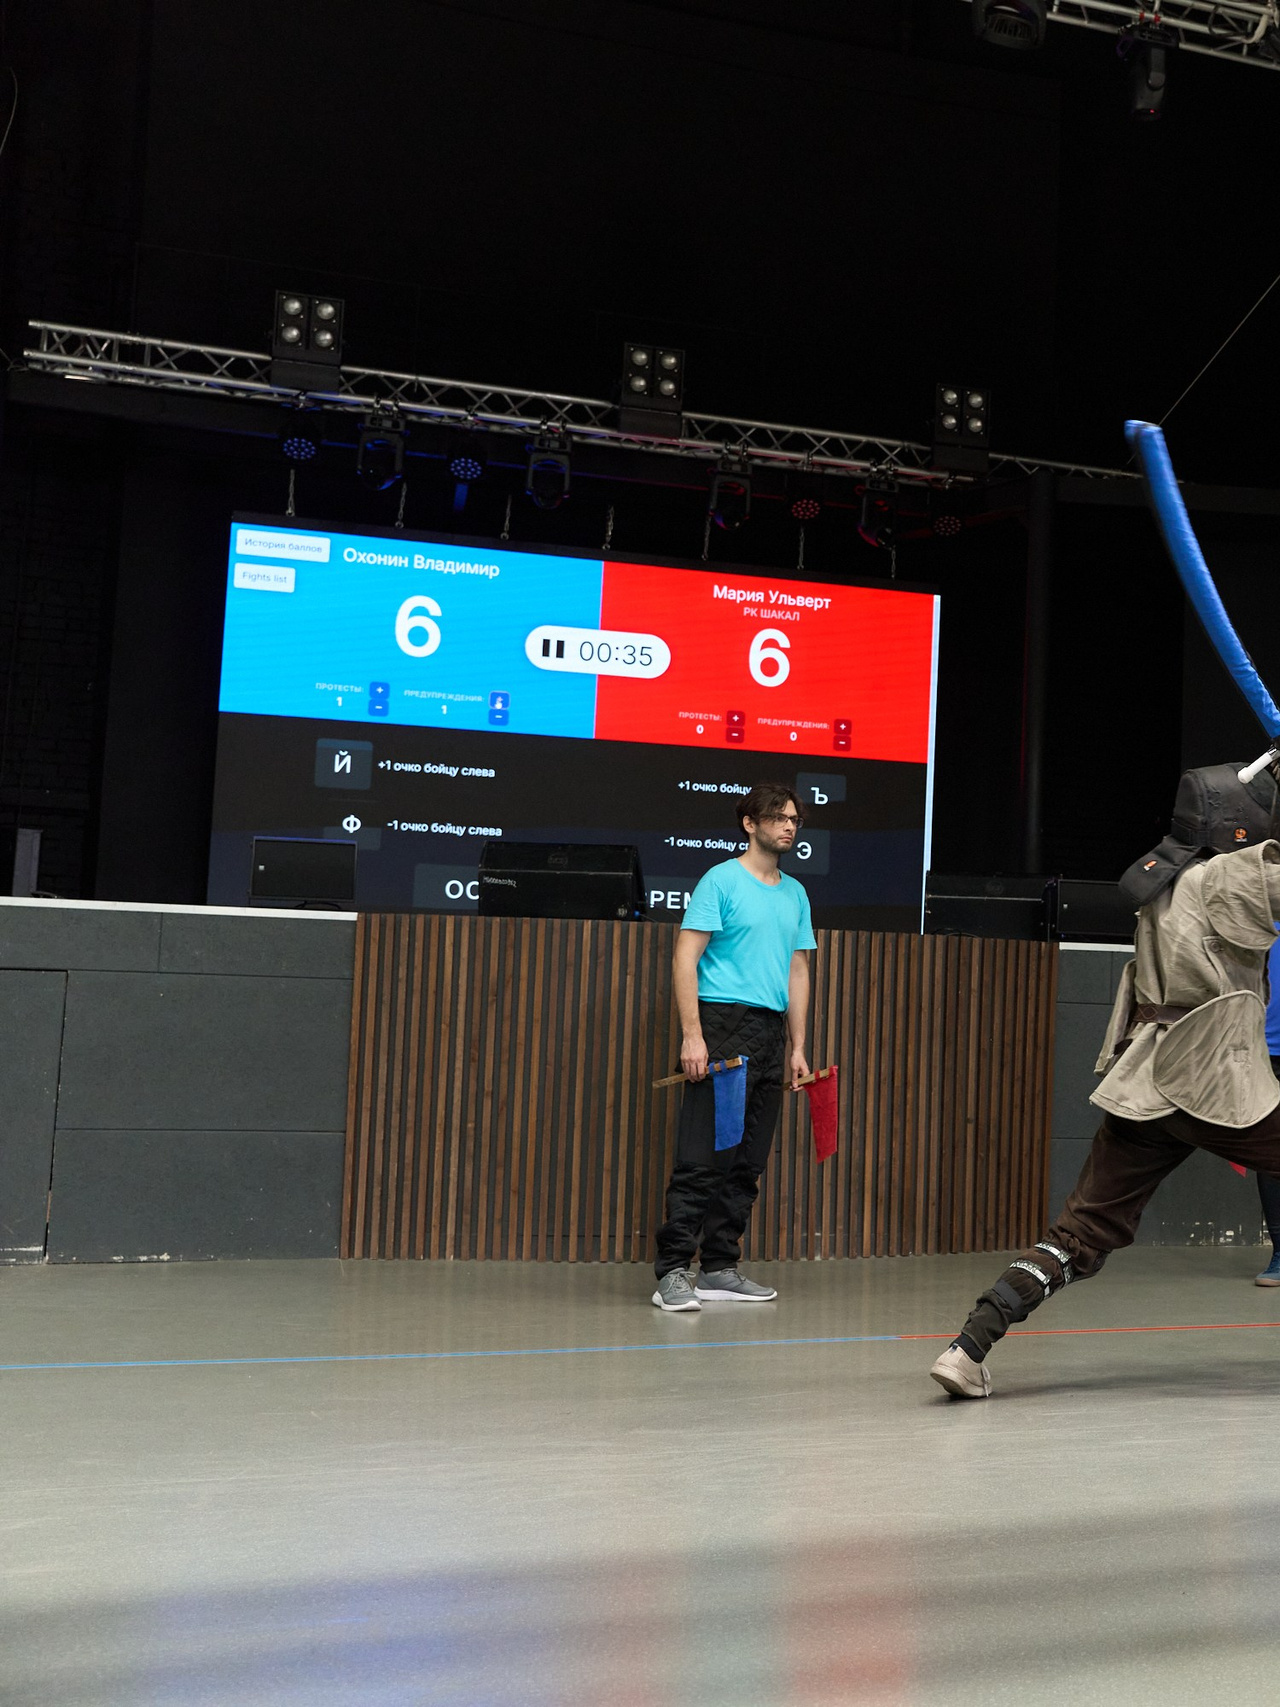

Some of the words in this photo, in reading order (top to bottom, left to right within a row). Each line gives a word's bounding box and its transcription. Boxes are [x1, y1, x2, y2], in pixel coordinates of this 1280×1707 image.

[244, 537, 287, 551] История
[288, 541, 324, 554] баллов
[343, 546, 410, 569] Охонин
[413, 553, 501, 579] Владимир
[242, 571, 271, 583] Fights
[273, 574, 288, 585] list
[713, 584, 765, 604] Мария
[768, 589, 832, 611] Ульверт
[743, 606, 759, 618] РК
[760, 608, 801, 622] ШАКАЛ
[394, 594, 443, 658] 6
[579, 640, 653, 667] 00:35
[748, 628, 791, 687] 6
[315, 681, 365, 694] ПРОТЕСТЫ:
[403, 689, 485, 703] ПРЕДУПРЕЖДЕНИЯ:
[335, 696, 343, 707] 1
[440, 704, 448, 715] 1
[678, 710, 723, 722] ПРОТЕСТЫ:
[757, 717, 830, 730] ПРЕДУПРЕЖДЕНИЯ:
[695, 723, 704, 735] 0
[789, 731, 798, 742] 0
[334, 750, 352, 774] Й
[377, 760, 391, 771] +1
[392, 761, 422, 774] очко
[422, 763, 460, 778] бойцу
[461, 766, 496, 778] слева
[678, 780, 690, 791] +1
[691, 782, 718, 794] очко
[719, 783, 753, 796] бойцу
[810, 786, 829, 805] Ъ
[342, 814, 362, 834] Ф
[386, 820, 399, 831] -1
[400, 821, 429, 833] очко
[430, 822, 467, 837] бойцу
[467, 826, 503, 837] слева
[664, 836, 675, 847] -1
[676, 838, 703, 849] очко
[704, 838, 737, 853] бойцу
[796, 841, 813, 860] Э
